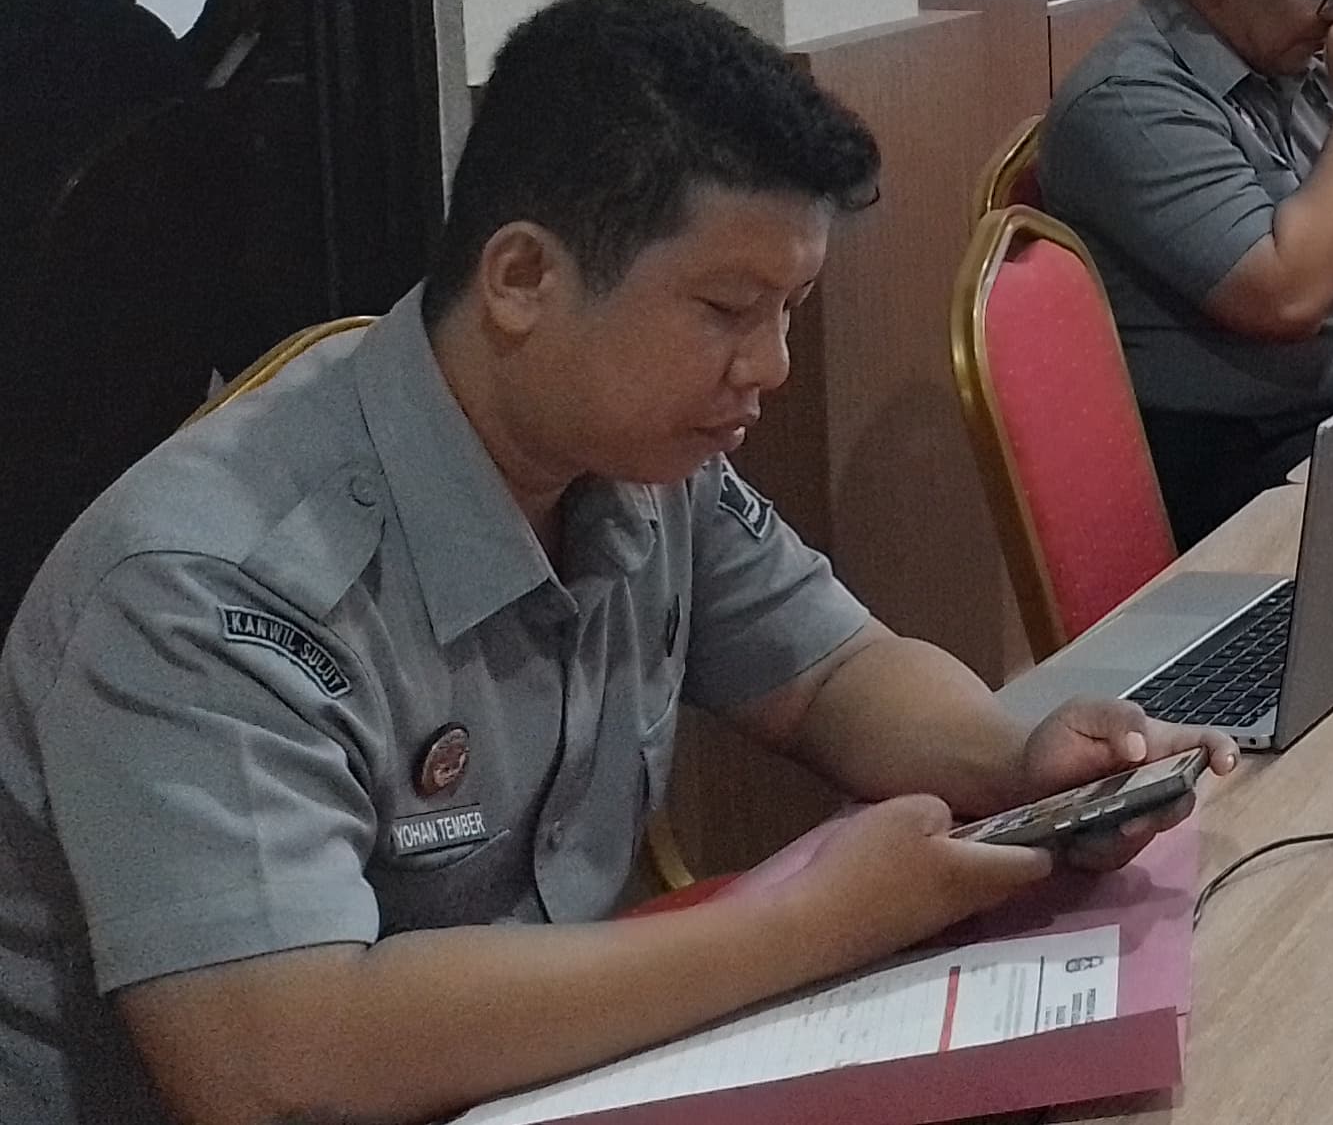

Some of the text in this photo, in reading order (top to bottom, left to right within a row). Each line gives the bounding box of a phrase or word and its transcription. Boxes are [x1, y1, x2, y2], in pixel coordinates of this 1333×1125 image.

[231, 611, 345, 689] KANWIL SULUT
[392, 810, 487, 850] YOHAN TEMBER
